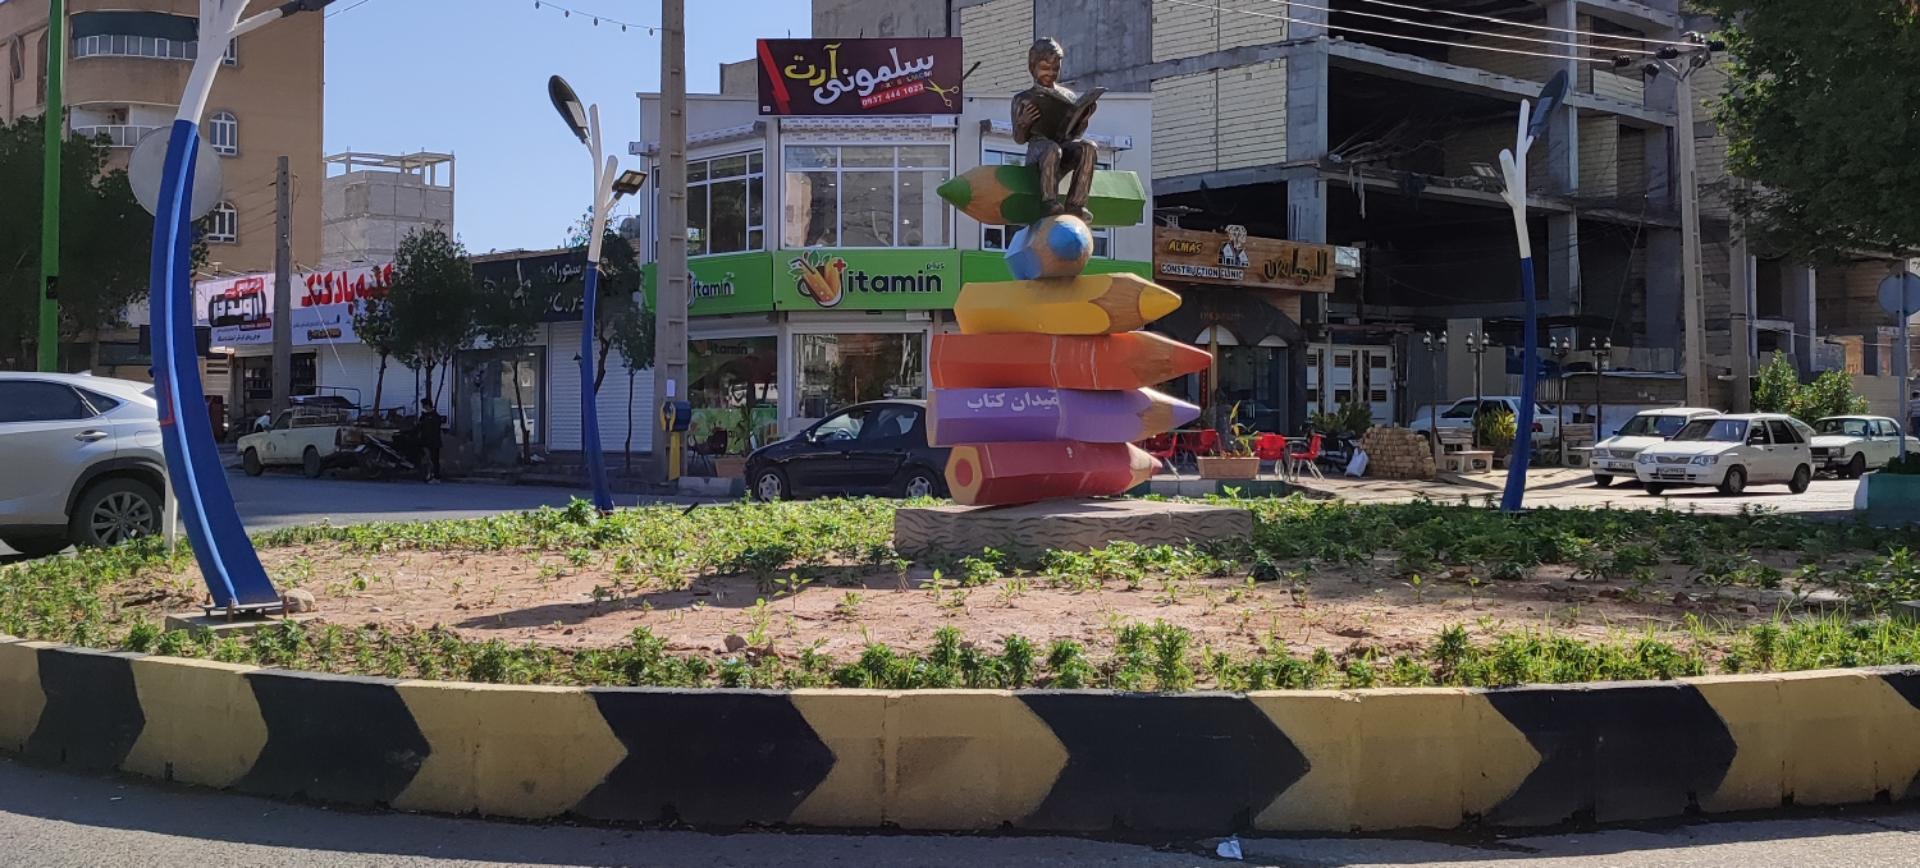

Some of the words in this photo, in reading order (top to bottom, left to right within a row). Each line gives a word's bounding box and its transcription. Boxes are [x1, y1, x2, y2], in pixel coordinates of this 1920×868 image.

[784, 42, 842, 87] آرت
[813, 47, 934, 105] سلمونی
[885, 89, 901, 99] 444
[904, 83, 923, 94] 1023
[1168, 238, 1203, 254] ALMAS
[926, 262, 946, 272] plus
[1161, 263, 1218, 278] CONSTRUCTION
[1219, 267, 1244, 281] CLINIC
[966, 392, 1006, 412] کتاب
[1010, 391, 1059, 412] میدان
